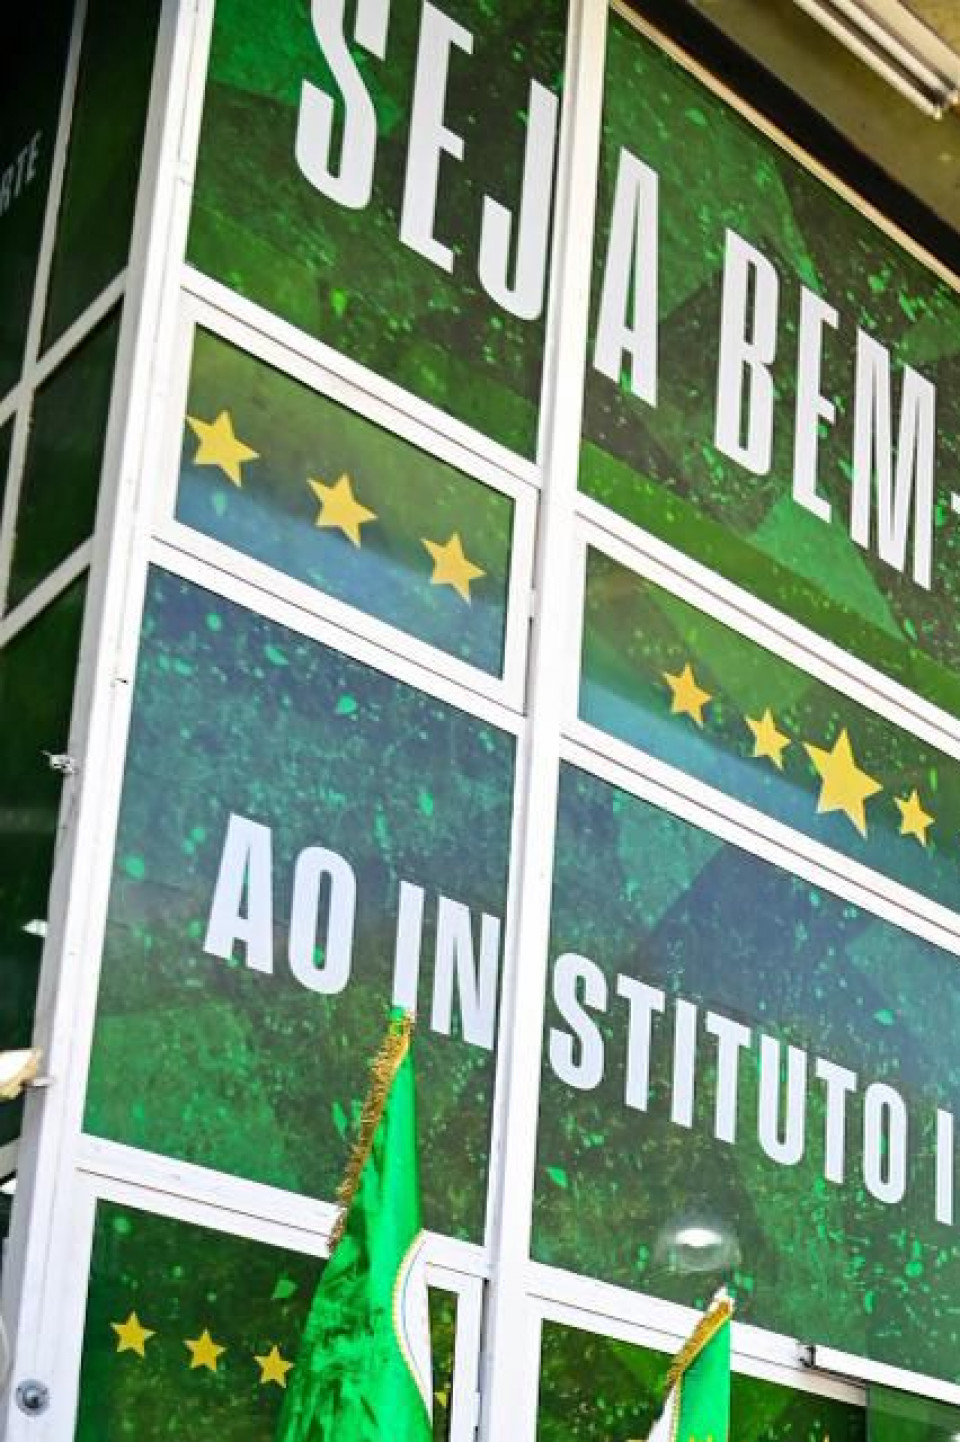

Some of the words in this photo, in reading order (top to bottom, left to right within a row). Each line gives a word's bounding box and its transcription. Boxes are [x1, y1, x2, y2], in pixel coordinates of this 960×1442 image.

[295, 0, 659, 408] SEJA
[203, 813, 357, 995] AO
[393, 880, 908, 1204] INSTITUTO
